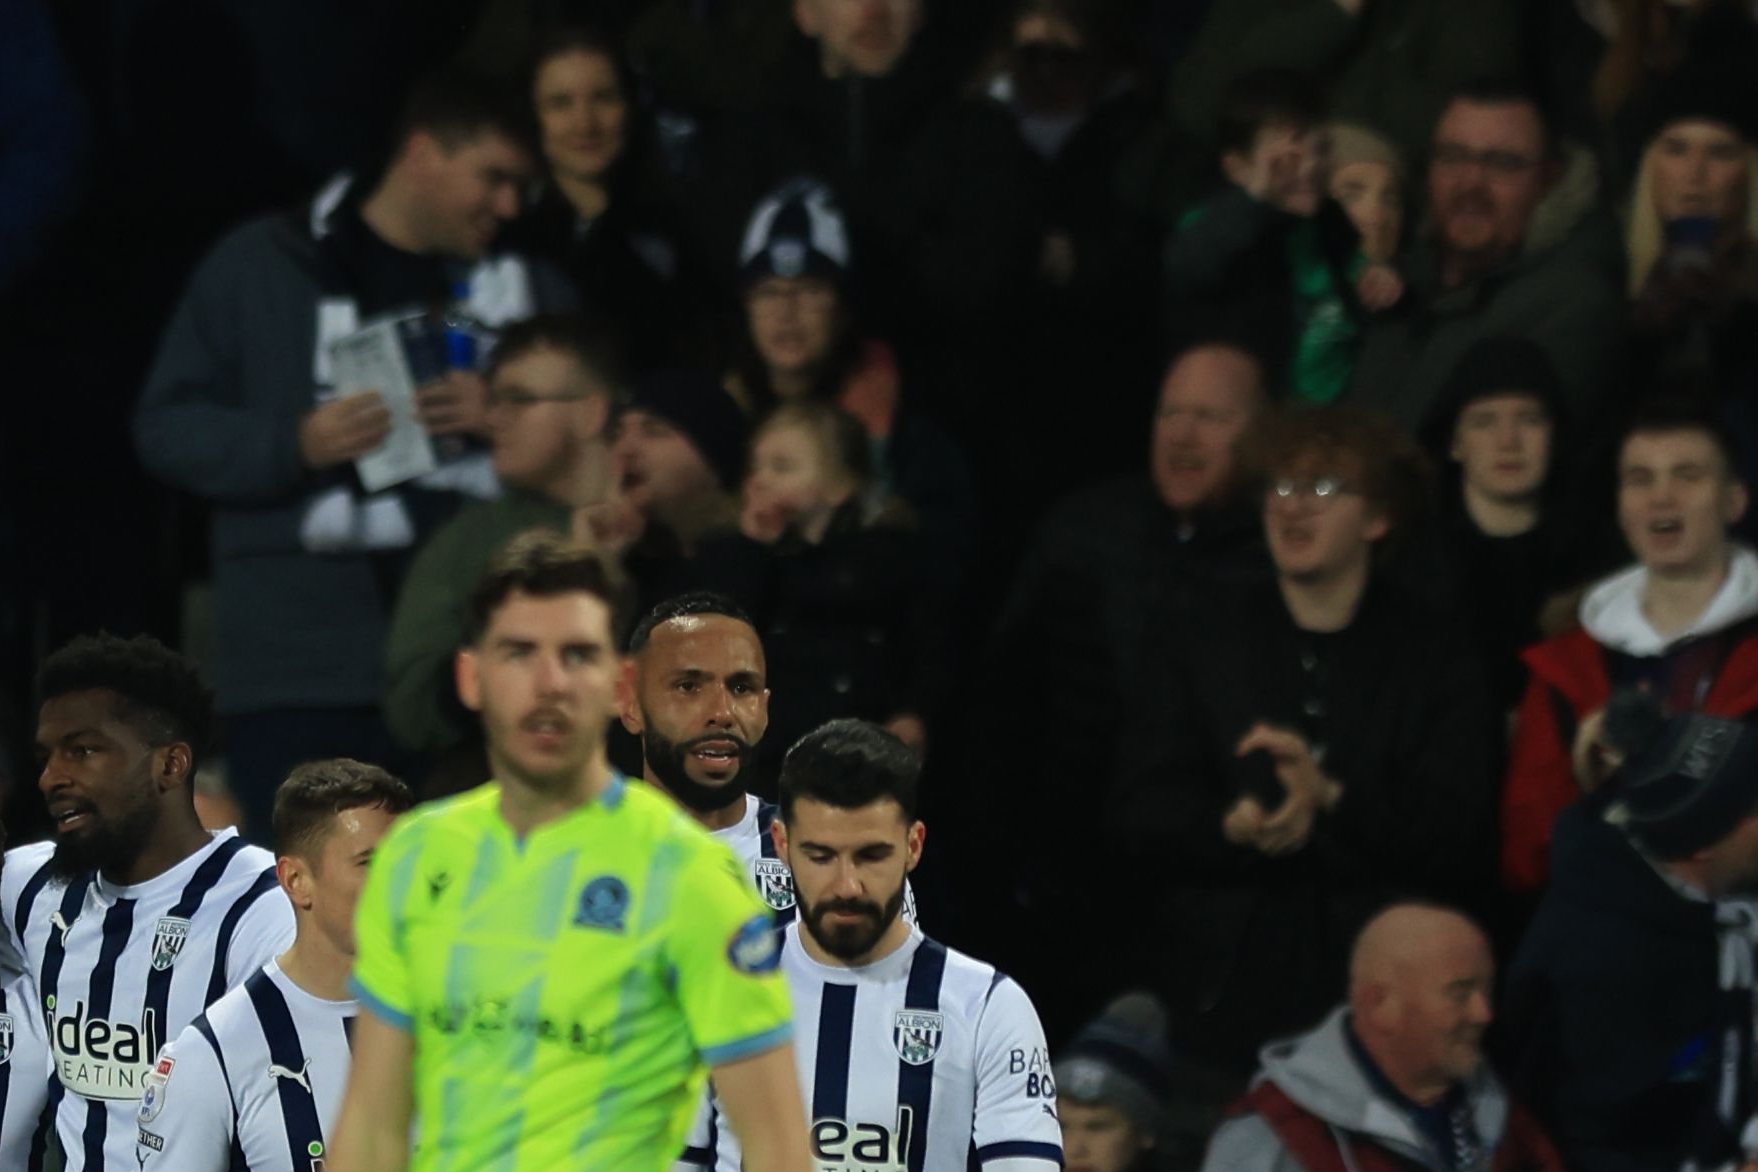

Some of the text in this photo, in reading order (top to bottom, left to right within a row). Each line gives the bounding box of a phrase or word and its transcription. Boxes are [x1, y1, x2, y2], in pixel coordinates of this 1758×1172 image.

[757, 865, 792, 876] ALBIO
[46, 994, 156, 1066] ideal
[897, 1017, 941, 1030] ALBION
[61, 1059, 151, 1089] EATIN
[809, 1105, 913, 1166] eal
